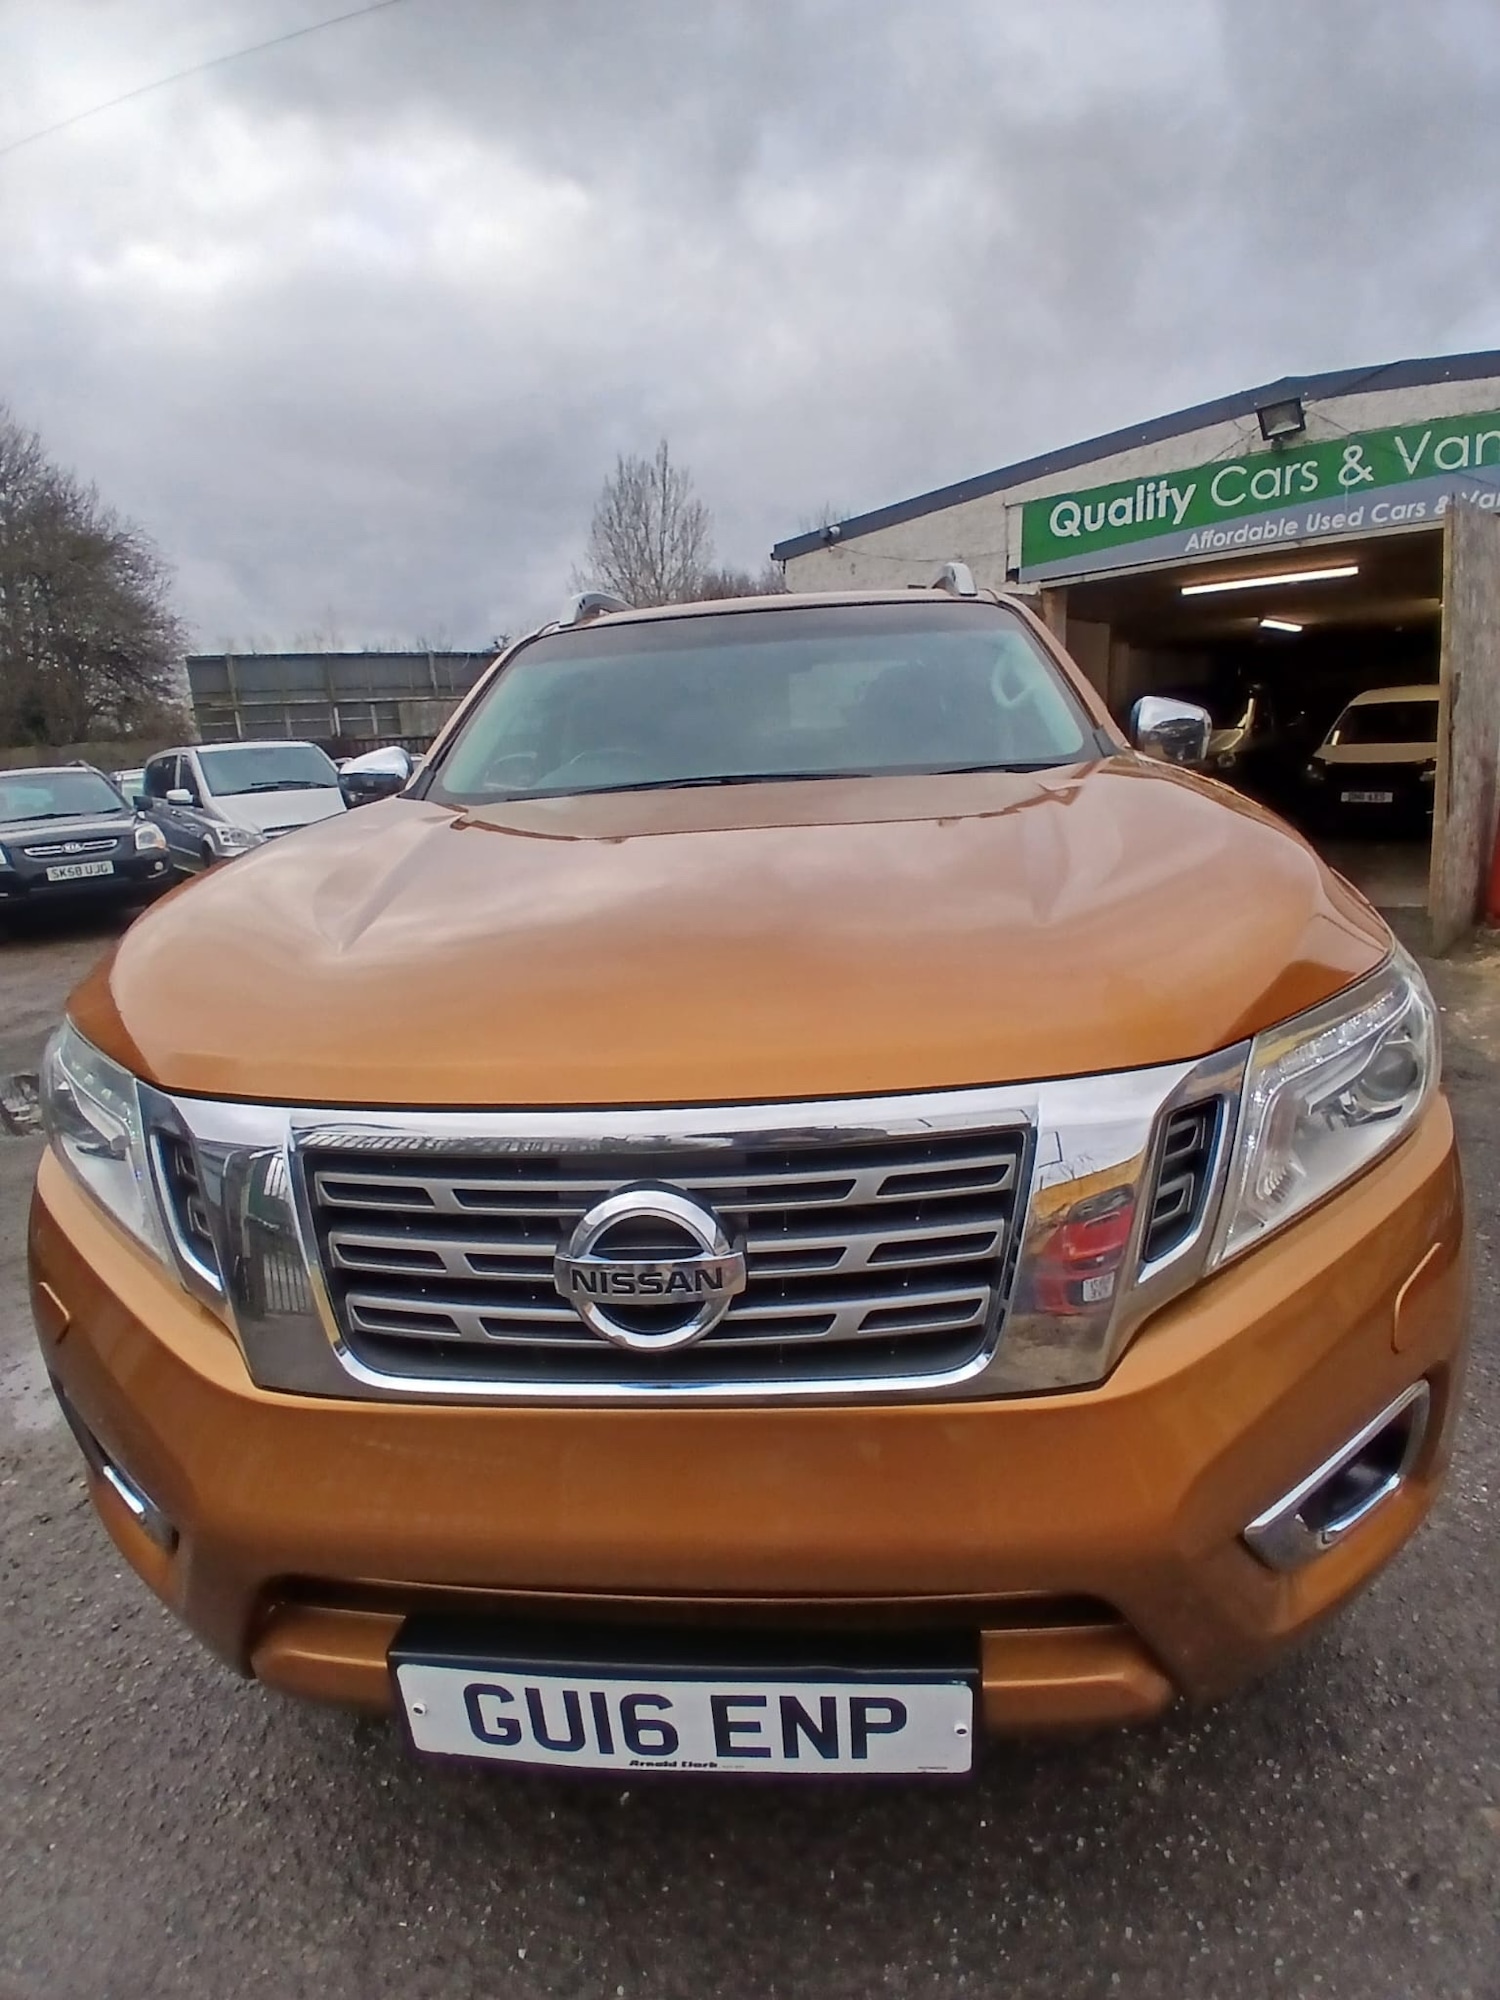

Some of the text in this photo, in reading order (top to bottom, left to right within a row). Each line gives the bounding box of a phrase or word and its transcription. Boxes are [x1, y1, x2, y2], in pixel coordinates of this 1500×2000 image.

[1050, 480, 1196, 537] Quality
[1211, 461, 1319, 507] Cars
[1338, 445, 1374, 487] &
[1184, 518, 1299, 552] Affordable
[1306, 506, 1364, 533] Used
[1370, 502, 1427, 524] Cars
[1434, 495, 1450, 514] &
[571, 1268, 723, 1295] NISSAN
[463, 1683, 907, 1759] GU16 ENP
[629, 1760, 678, 1768] Arnold
[681, 1761, 718, 1769] Clark
